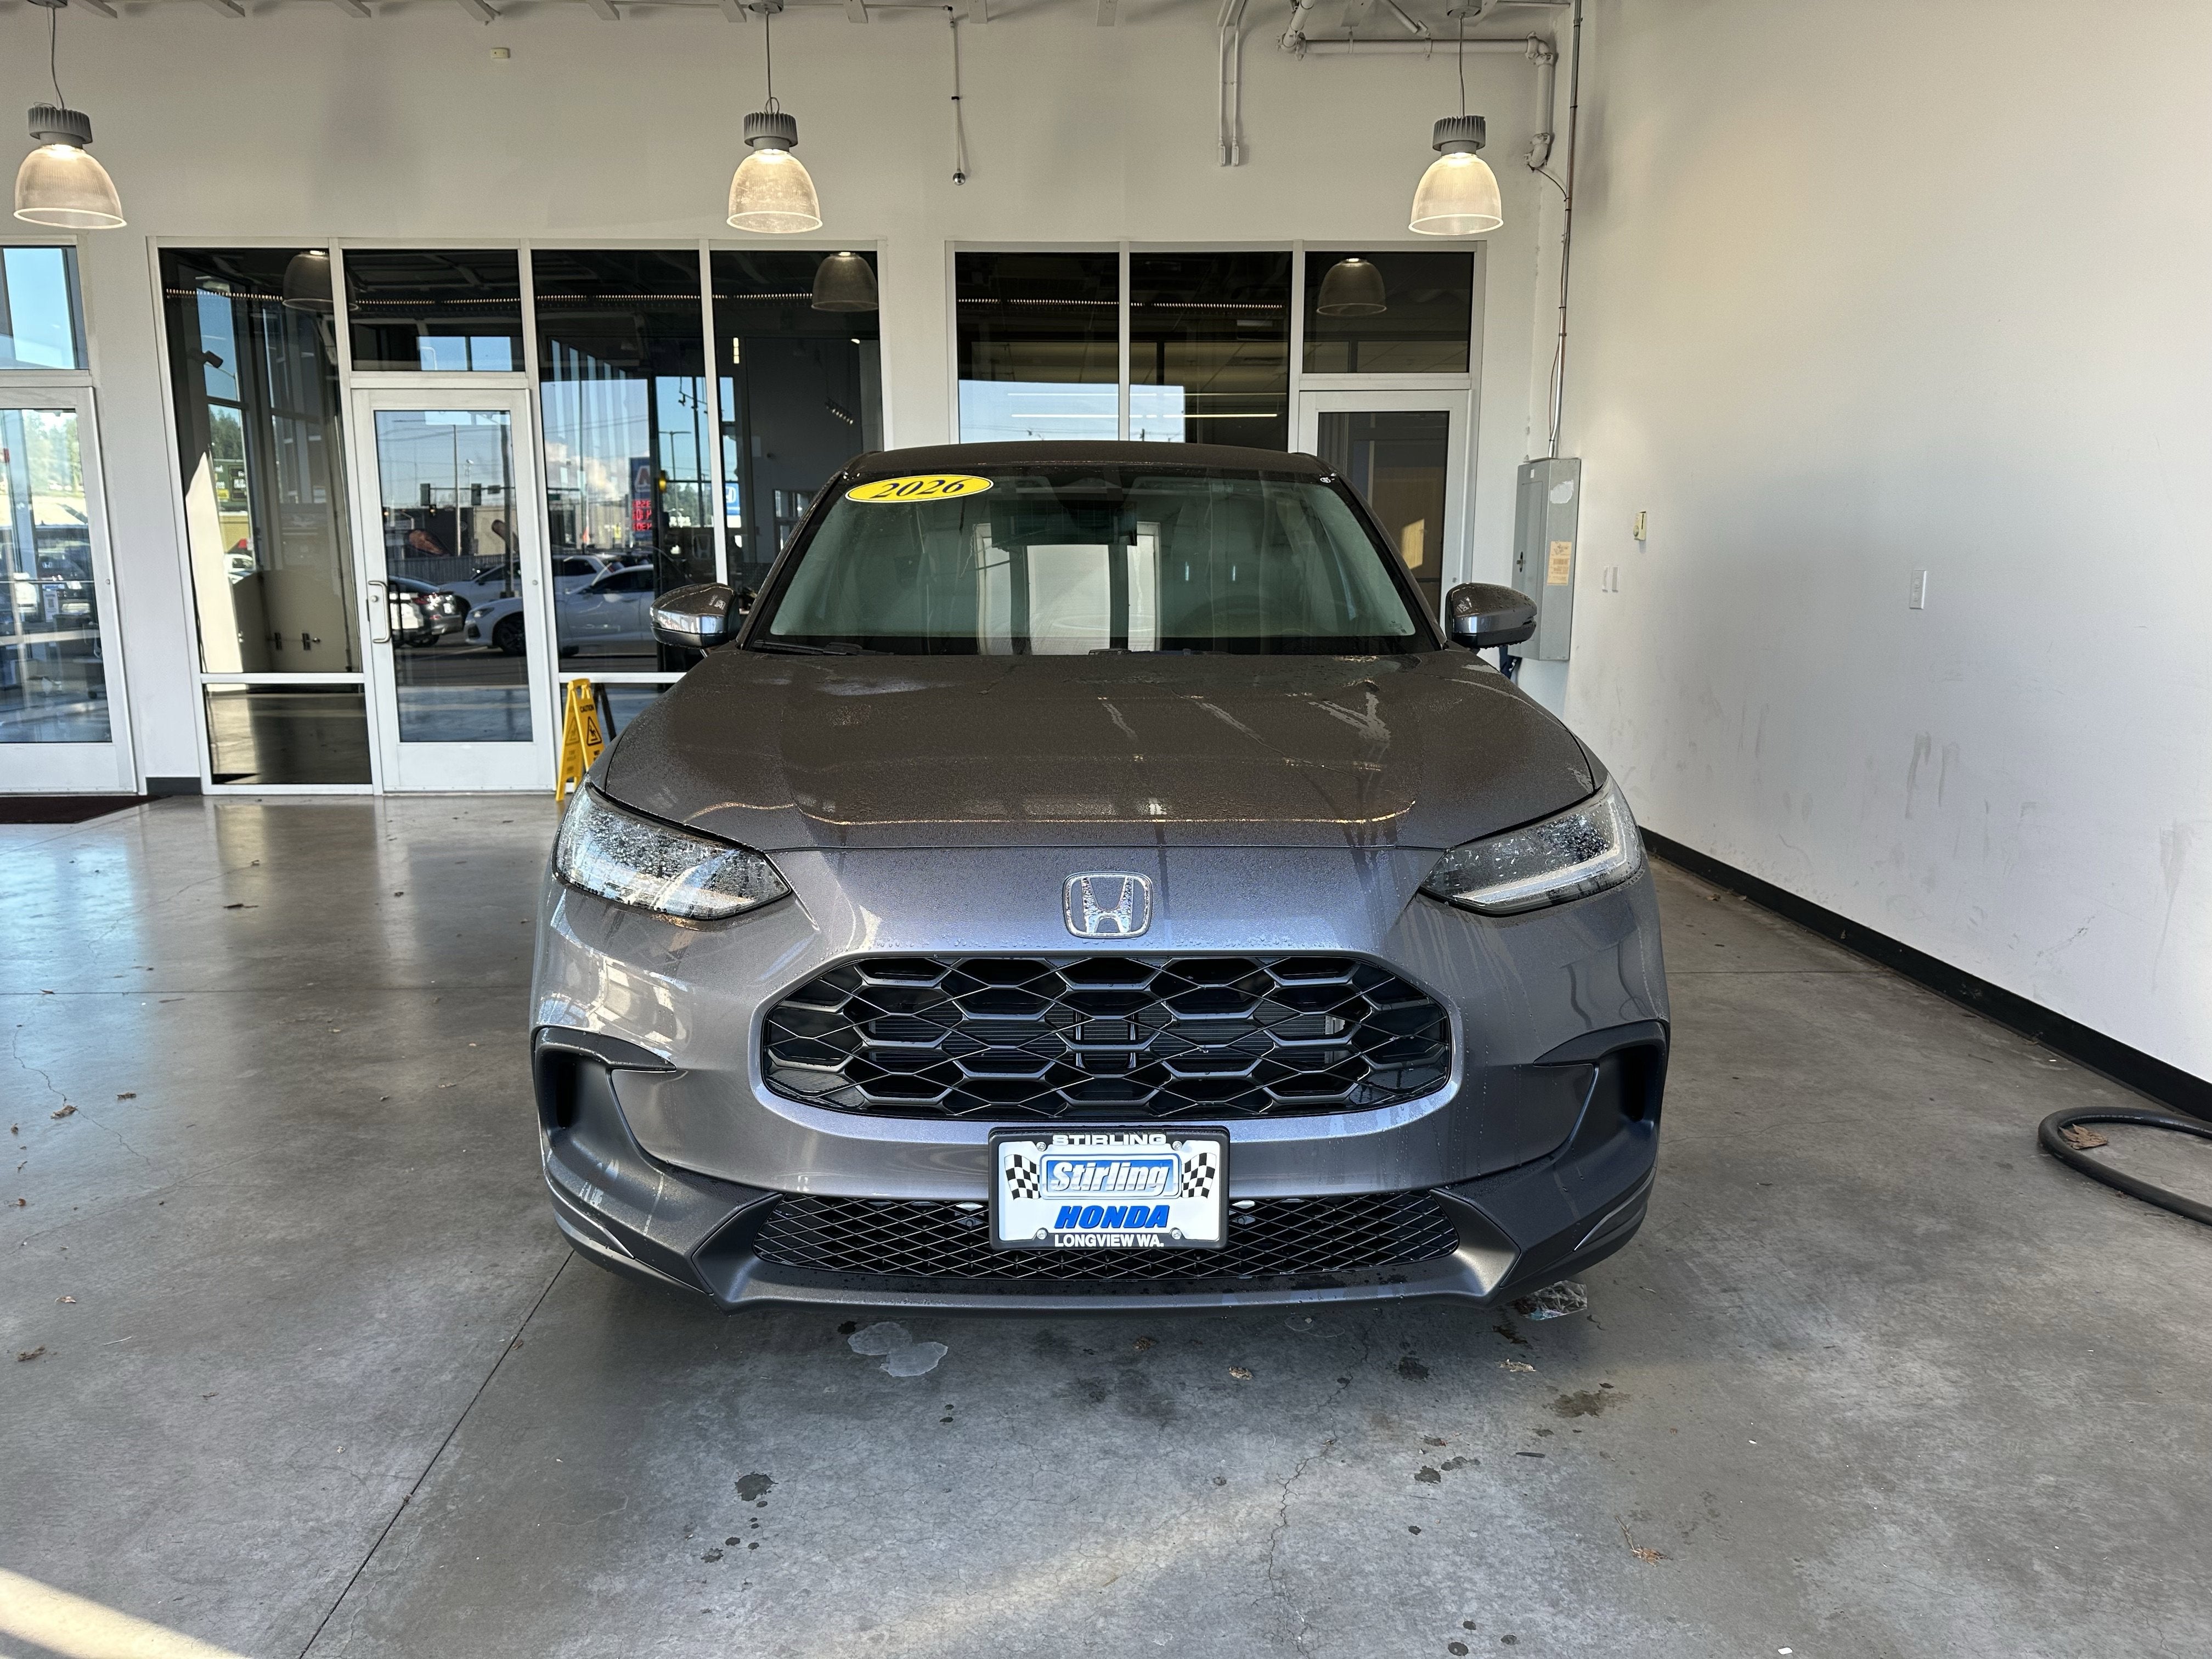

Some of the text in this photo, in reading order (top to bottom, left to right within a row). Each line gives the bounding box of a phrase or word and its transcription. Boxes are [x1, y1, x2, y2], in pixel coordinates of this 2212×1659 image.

[869, 478, 973, 499] 2026
[1052, 1133, 1166, 1146] STIRLING
[1050, 1161, 1170, 1194] Stirling
[1054, 1205, 1170, 1229] HONDA
[1054, 1234, 1164, 1247] LONGVIEW WA.
